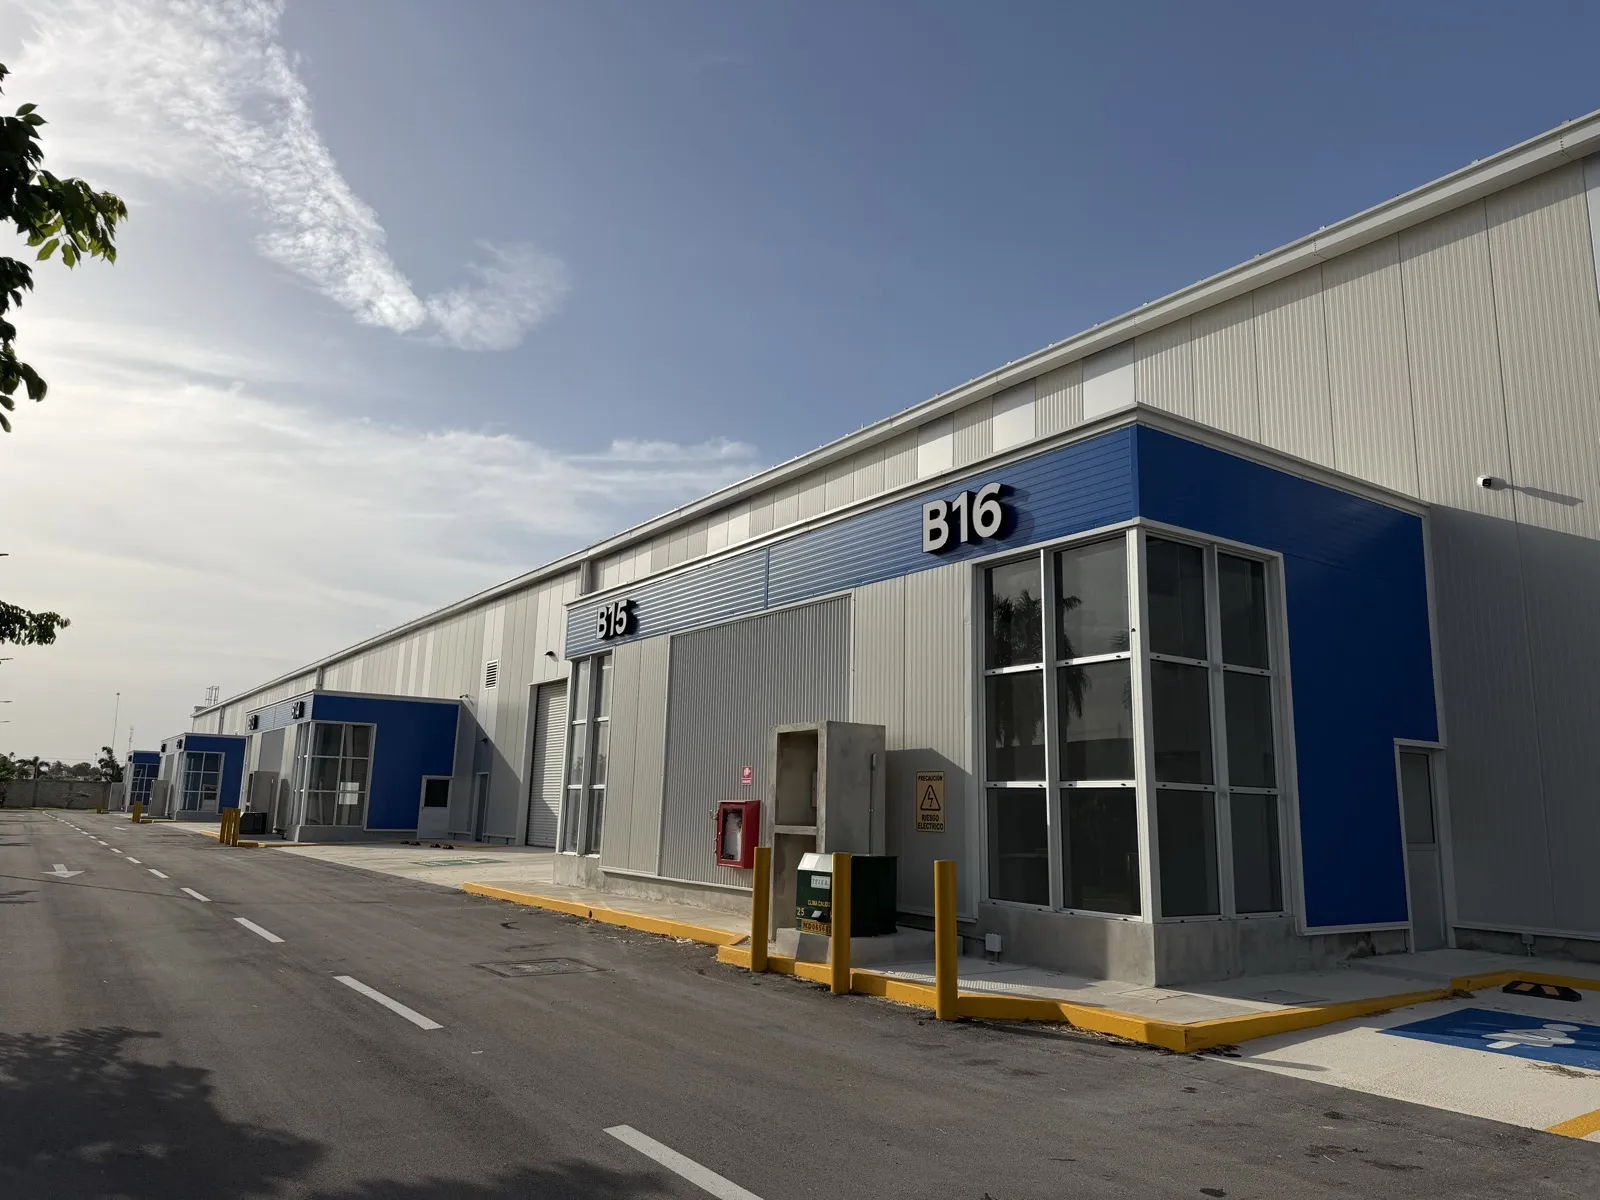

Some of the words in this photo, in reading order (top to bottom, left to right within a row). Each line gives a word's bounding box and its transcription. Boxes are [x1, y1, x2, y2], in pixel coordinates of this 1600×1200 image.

[922, 482, 1002, 553] B16
[596, 599, 628, 639] B15
[921, 813, 940, 822] RIESGO
[796, 907, 805, 916] 25
